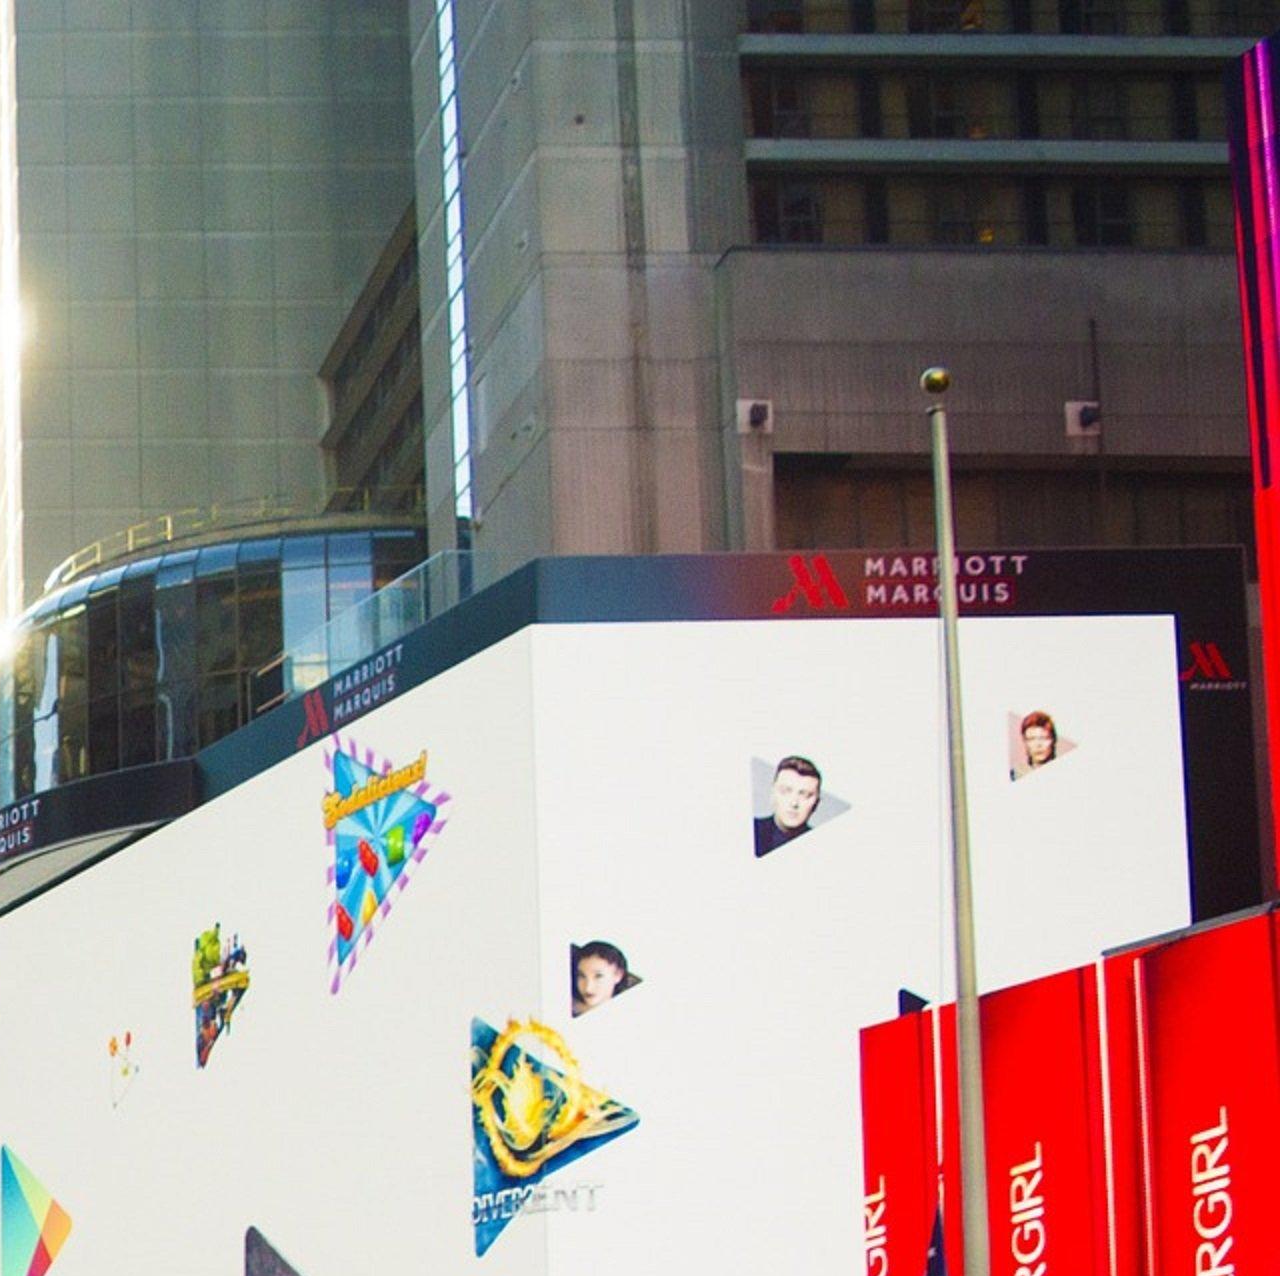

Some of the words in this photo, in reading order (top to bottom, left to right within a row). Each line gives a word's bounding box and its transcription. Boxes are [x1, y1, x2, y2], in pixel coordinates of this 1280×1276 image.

[865, 556, 1028, 577] MAROTT
[333, 643, 403, 698] MARRIOTT
[333, 675, 395, 722] MARQUIS
